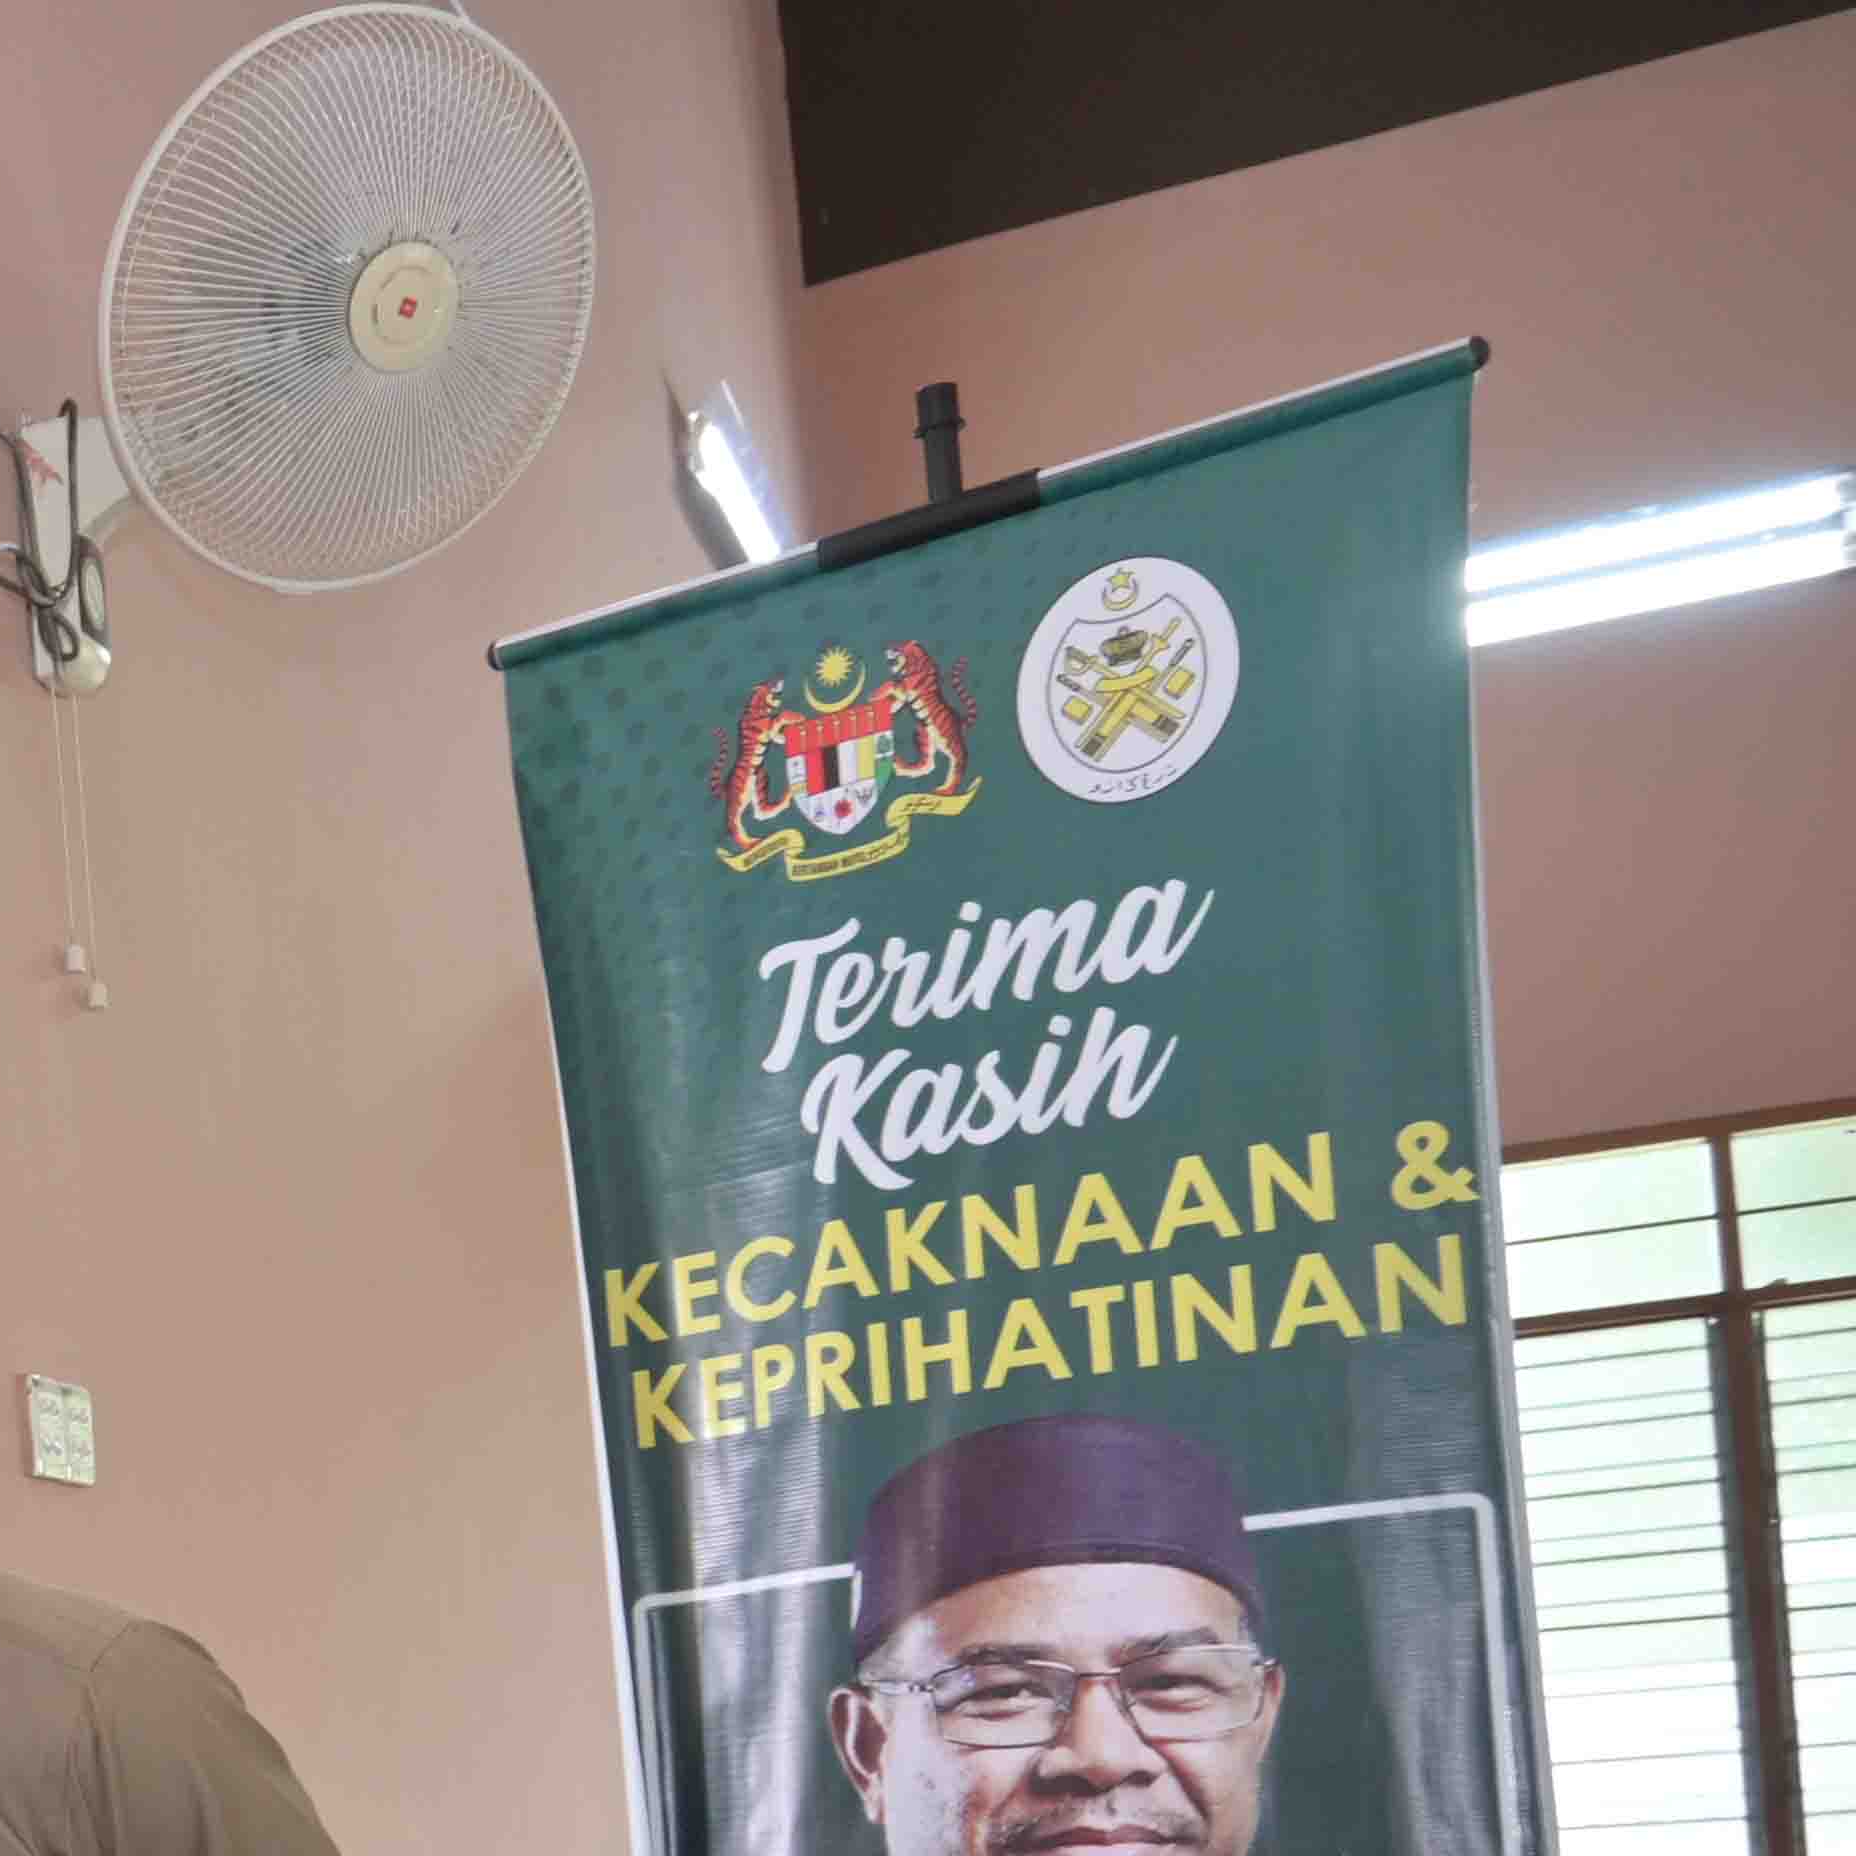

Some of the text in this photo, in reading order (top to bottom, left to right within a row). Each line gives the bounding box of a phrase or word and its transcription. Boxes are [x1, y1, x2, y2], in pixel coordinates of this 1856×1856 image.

[759, 876, 1214, 1074] Terima
[800, 1006, 1178, 1191] Kasih
[604, 1119, 1480, 1349] KECAKNAAN &
[632, 1233, 1469, 1449] KEPRIHATINAN
